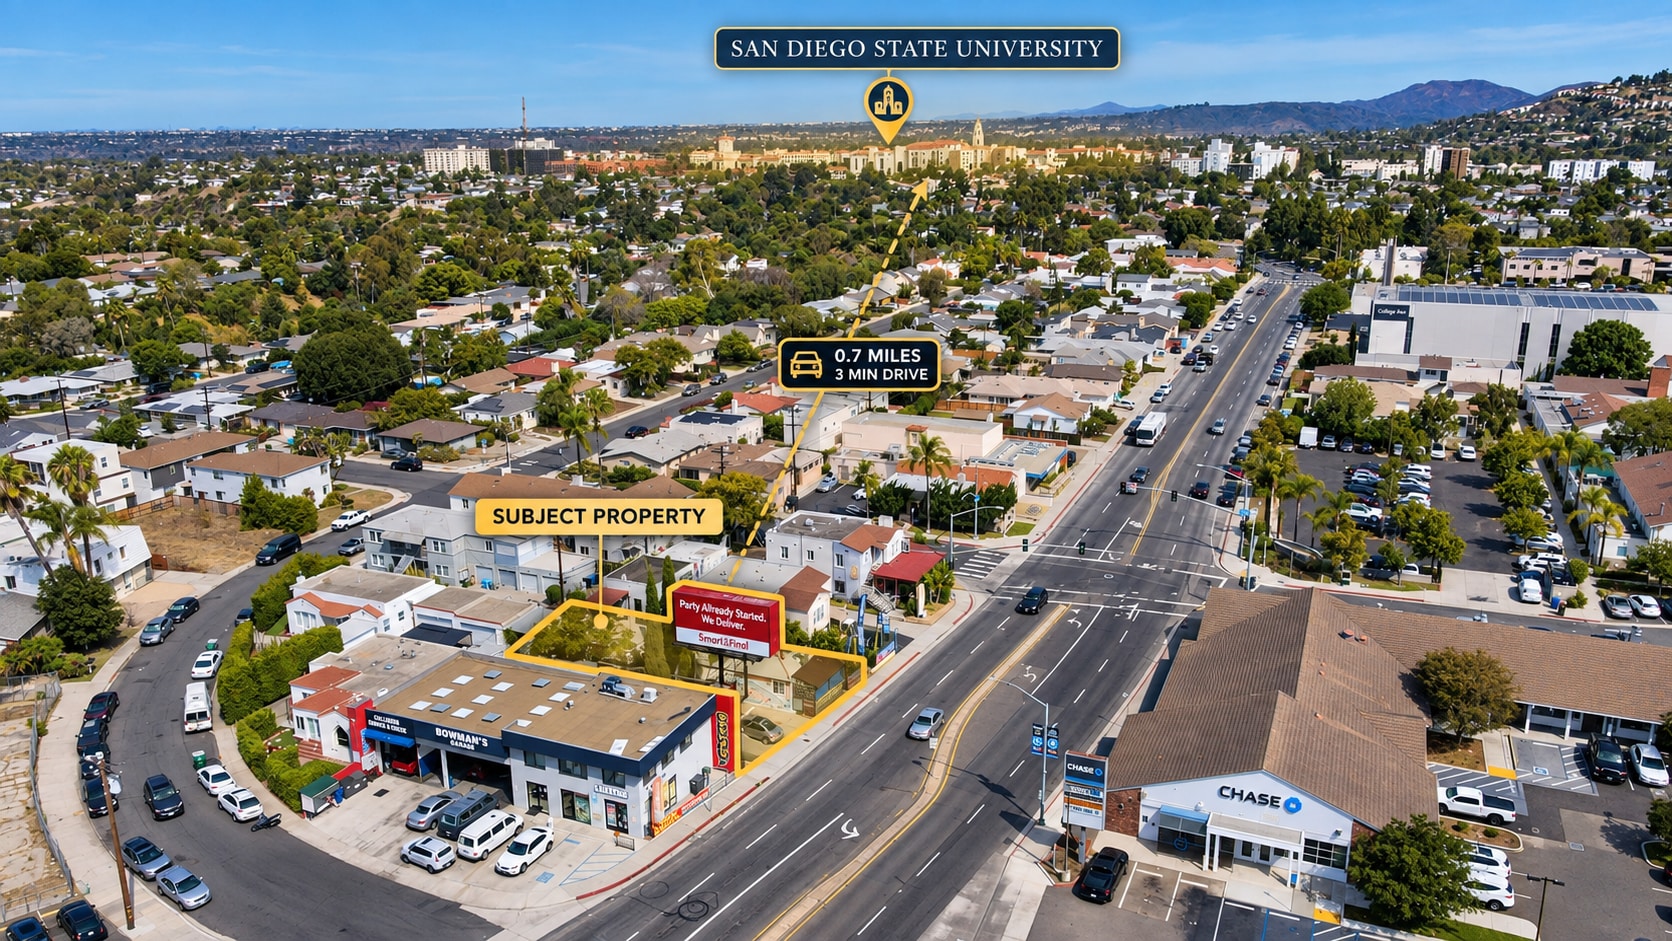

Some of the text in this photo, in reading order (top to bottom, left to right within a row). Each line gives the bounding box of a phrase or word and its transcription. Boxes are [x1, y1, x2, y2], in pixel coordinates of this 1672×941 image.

[680, 599, 700, 613] Party
[735, 609, 767, 622] Started.
[701, 614, 746, 631] We Deliver.
[435, 728, 488, 747] BOWMAN'S
[1067, 763, 1095, 775] CHASE
[1219, 785, 1282, 809] CHASE
